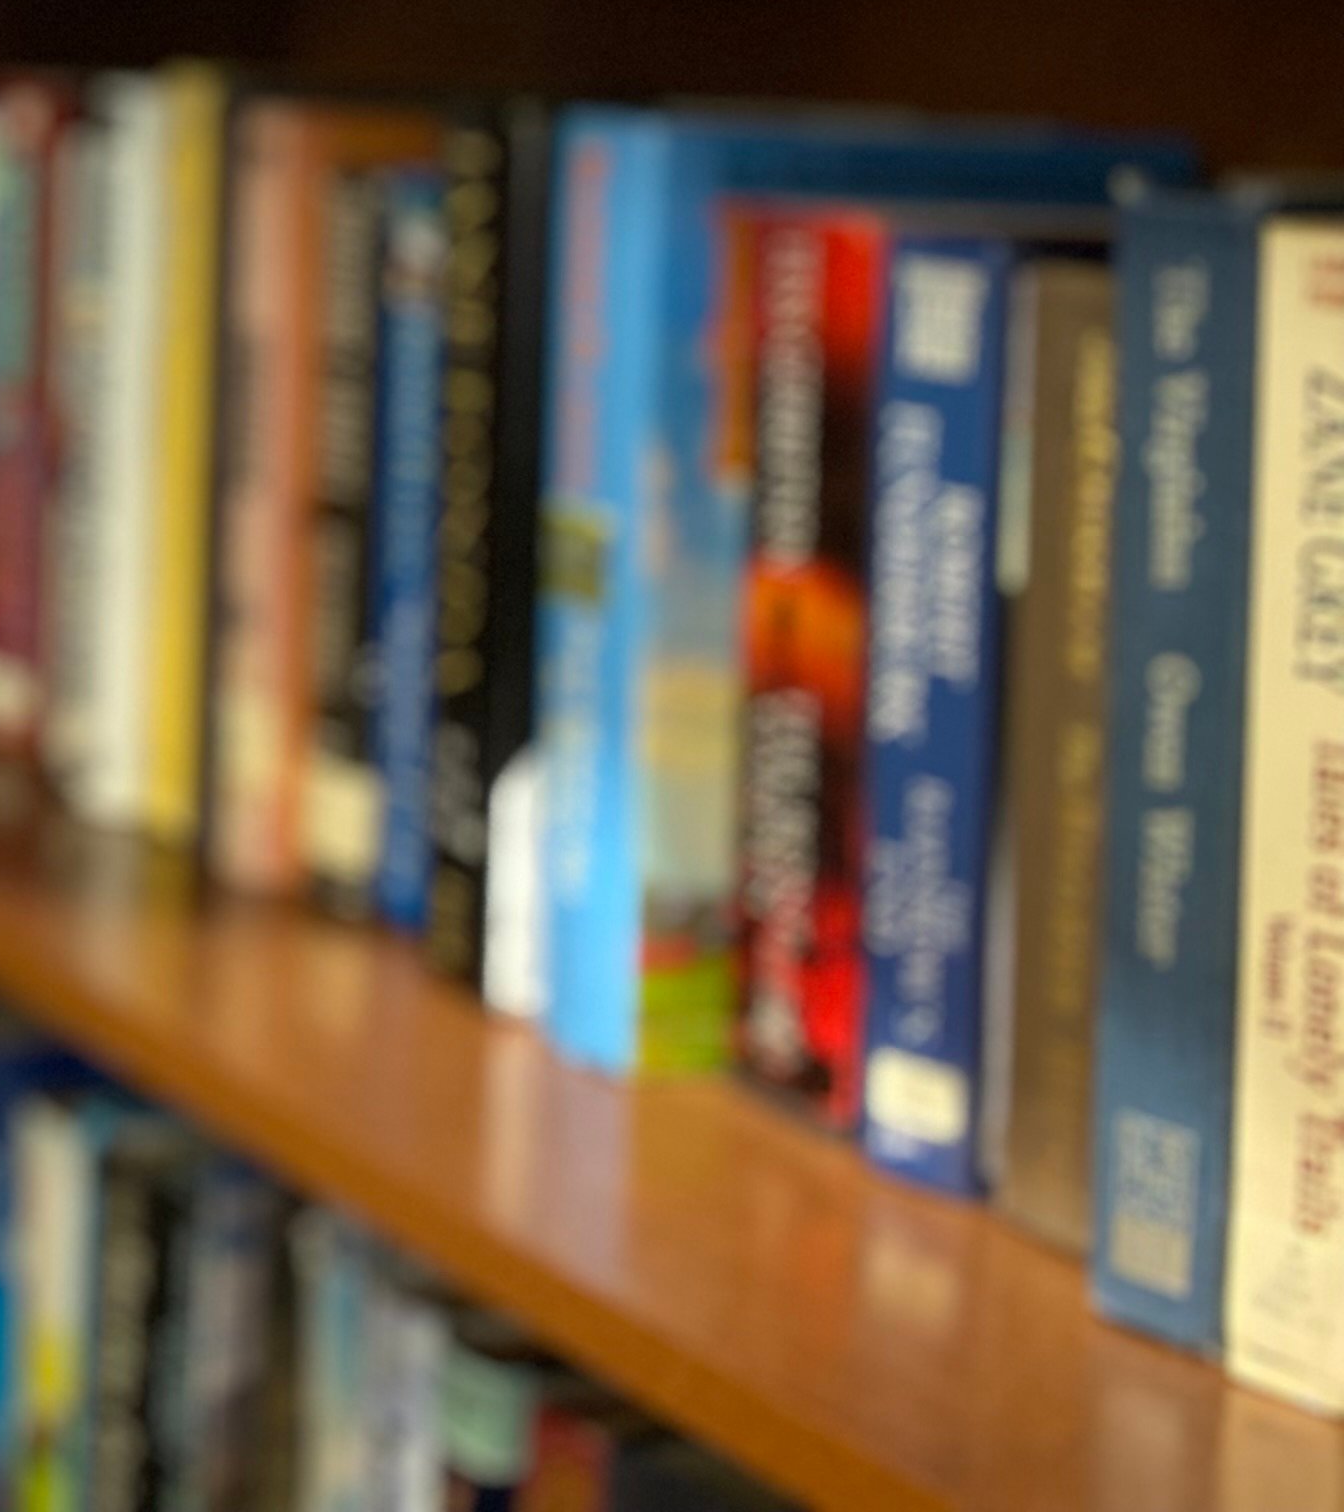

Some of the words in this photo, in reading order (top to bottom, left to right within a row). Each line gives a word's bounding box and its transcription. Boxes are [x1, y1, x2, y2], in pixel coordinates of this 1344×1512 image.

[1154, 260, 1208, 356] The
[1142, 370, 1205, 590] Virginian
[1300, 365, 1344, 525] ZANE
[1292, 533, 1344, 686] GREY
[1138, 651, 1202, 791] Owen
[1133, 805, 1196, 968] Wister
[1306, 847, 1344, 915] of
[1265, 914, 1298, 1004] Volume
[1293, 926, 1344, 1093] Lonely
[1294, 1108, 1344, 1238] Trails
